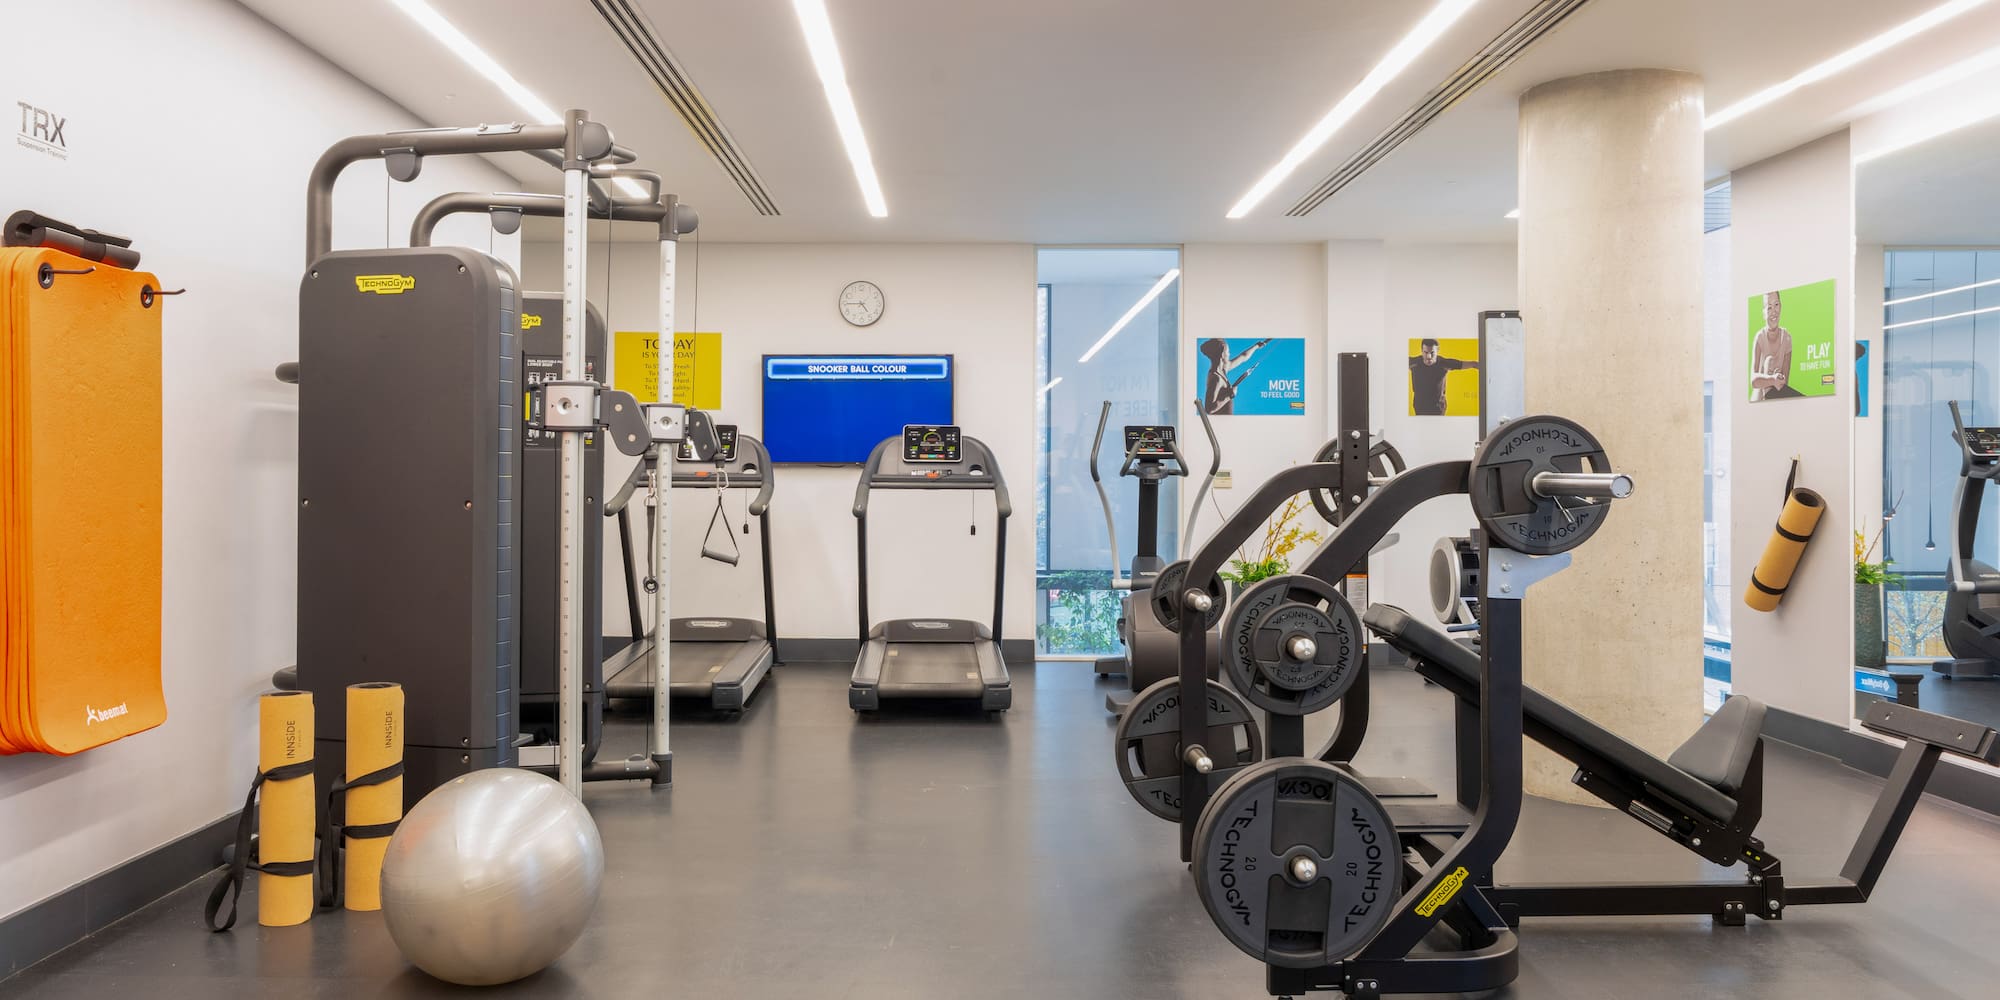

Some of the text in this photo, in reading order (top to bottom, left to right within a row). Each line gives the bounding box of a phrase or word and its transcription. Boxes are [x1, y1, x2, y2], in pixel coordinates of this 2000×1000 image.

[17, 101, 66, 147] TRX
[1807, 341, 1831, 360] PLAY
[808, 365, 907, 373] SNOOKER BALL COLOUR
[1260, 391, 1300, 399] TO FEEL GOOD
[1269, 379, 1300, 391] MOVE
[1499, 429, 1583, 457] TECHNOGYM
[1508, 513, 1590, 541] TECHNOGYM
[1238, 593, 1277, 672] TECHNOGYM
[1312, 618, 1350, 697] TECHNOGYM
[1142, 696, 1231, 725] TEOGYM
[1219, 799, 1258, 926] TECHNOGYM
[1245, 856, 1257, 872] 20
[1344, 807, 1382, 933] TECHNOGYM
[1346, 862, 1358, 877] 20
[1417, 869, 1465, 915] TECHNOGYM
